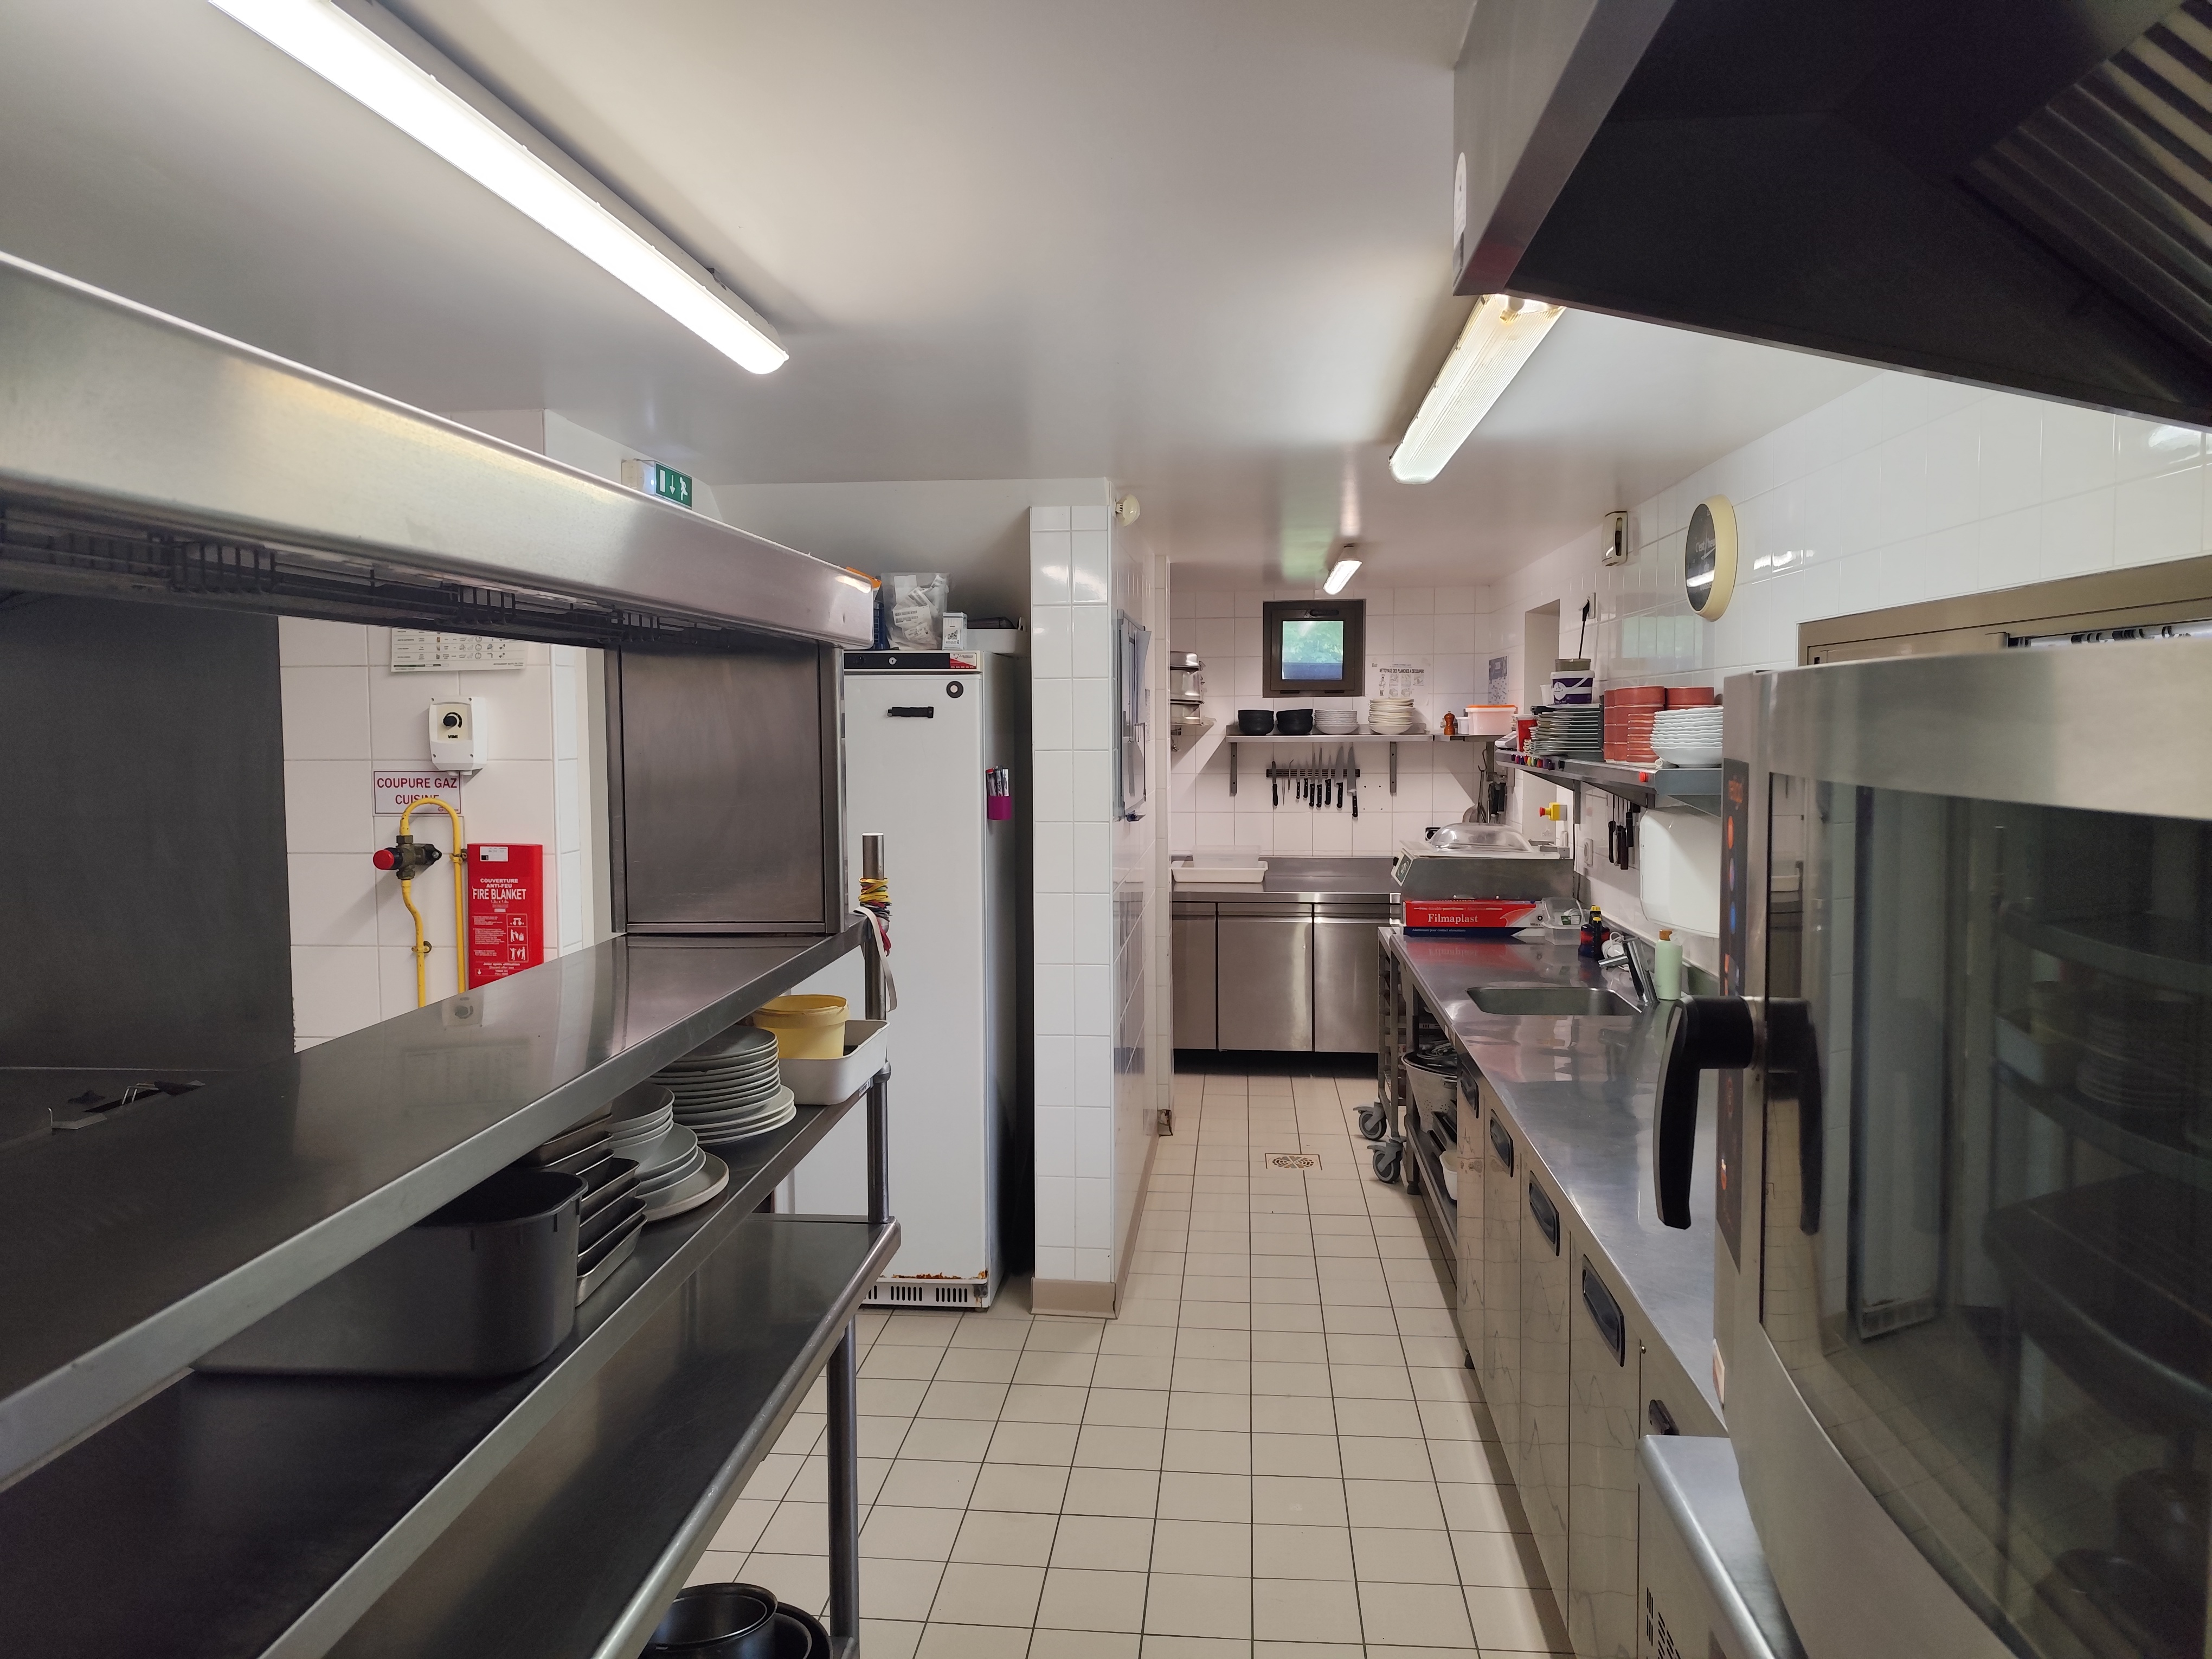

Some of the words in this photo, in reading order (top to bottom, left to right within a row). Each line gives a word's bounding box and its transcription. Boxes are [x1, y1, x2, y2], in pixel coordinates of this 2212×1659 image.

[377, 777, 431, 788] COUPURE
[434, 777, 458, 788] GAZ
[472, 888, 490, 900] FIRE
[491, 889, 527, 900] BLANKET
[1427, 914, 1478, 924] Filmaplast
